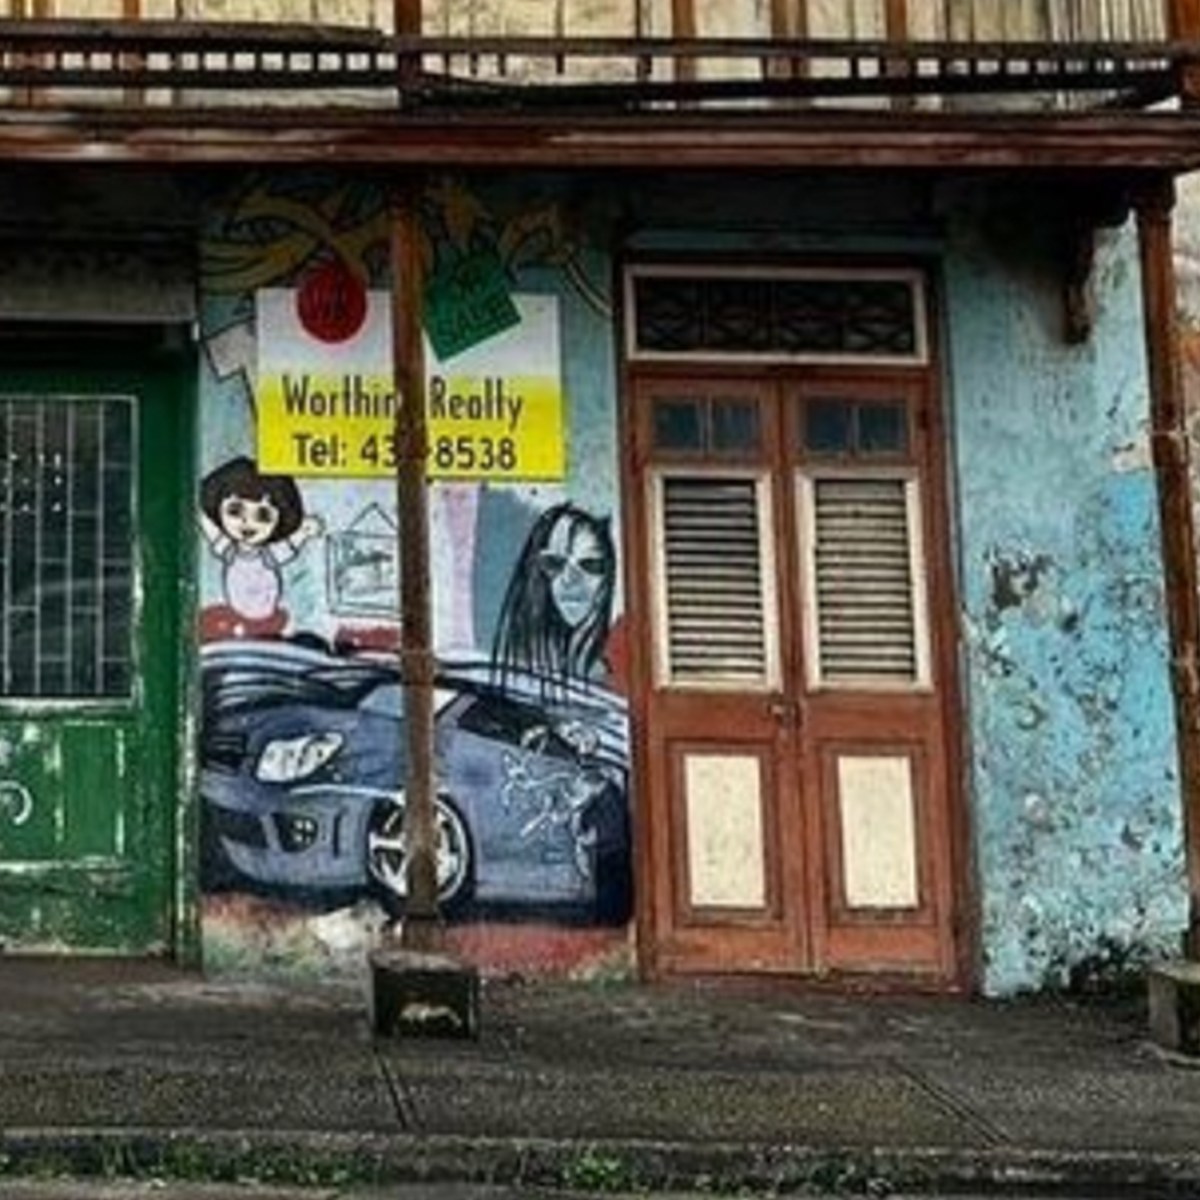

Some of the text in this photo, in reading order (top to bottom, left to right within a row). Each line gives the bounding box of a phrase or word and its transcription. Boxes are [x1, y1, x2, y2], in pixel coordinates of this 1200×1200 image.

[282, 374, 523, 428] Worthin Realty
[292, 433, 517, 471] Tel: 43-8538
